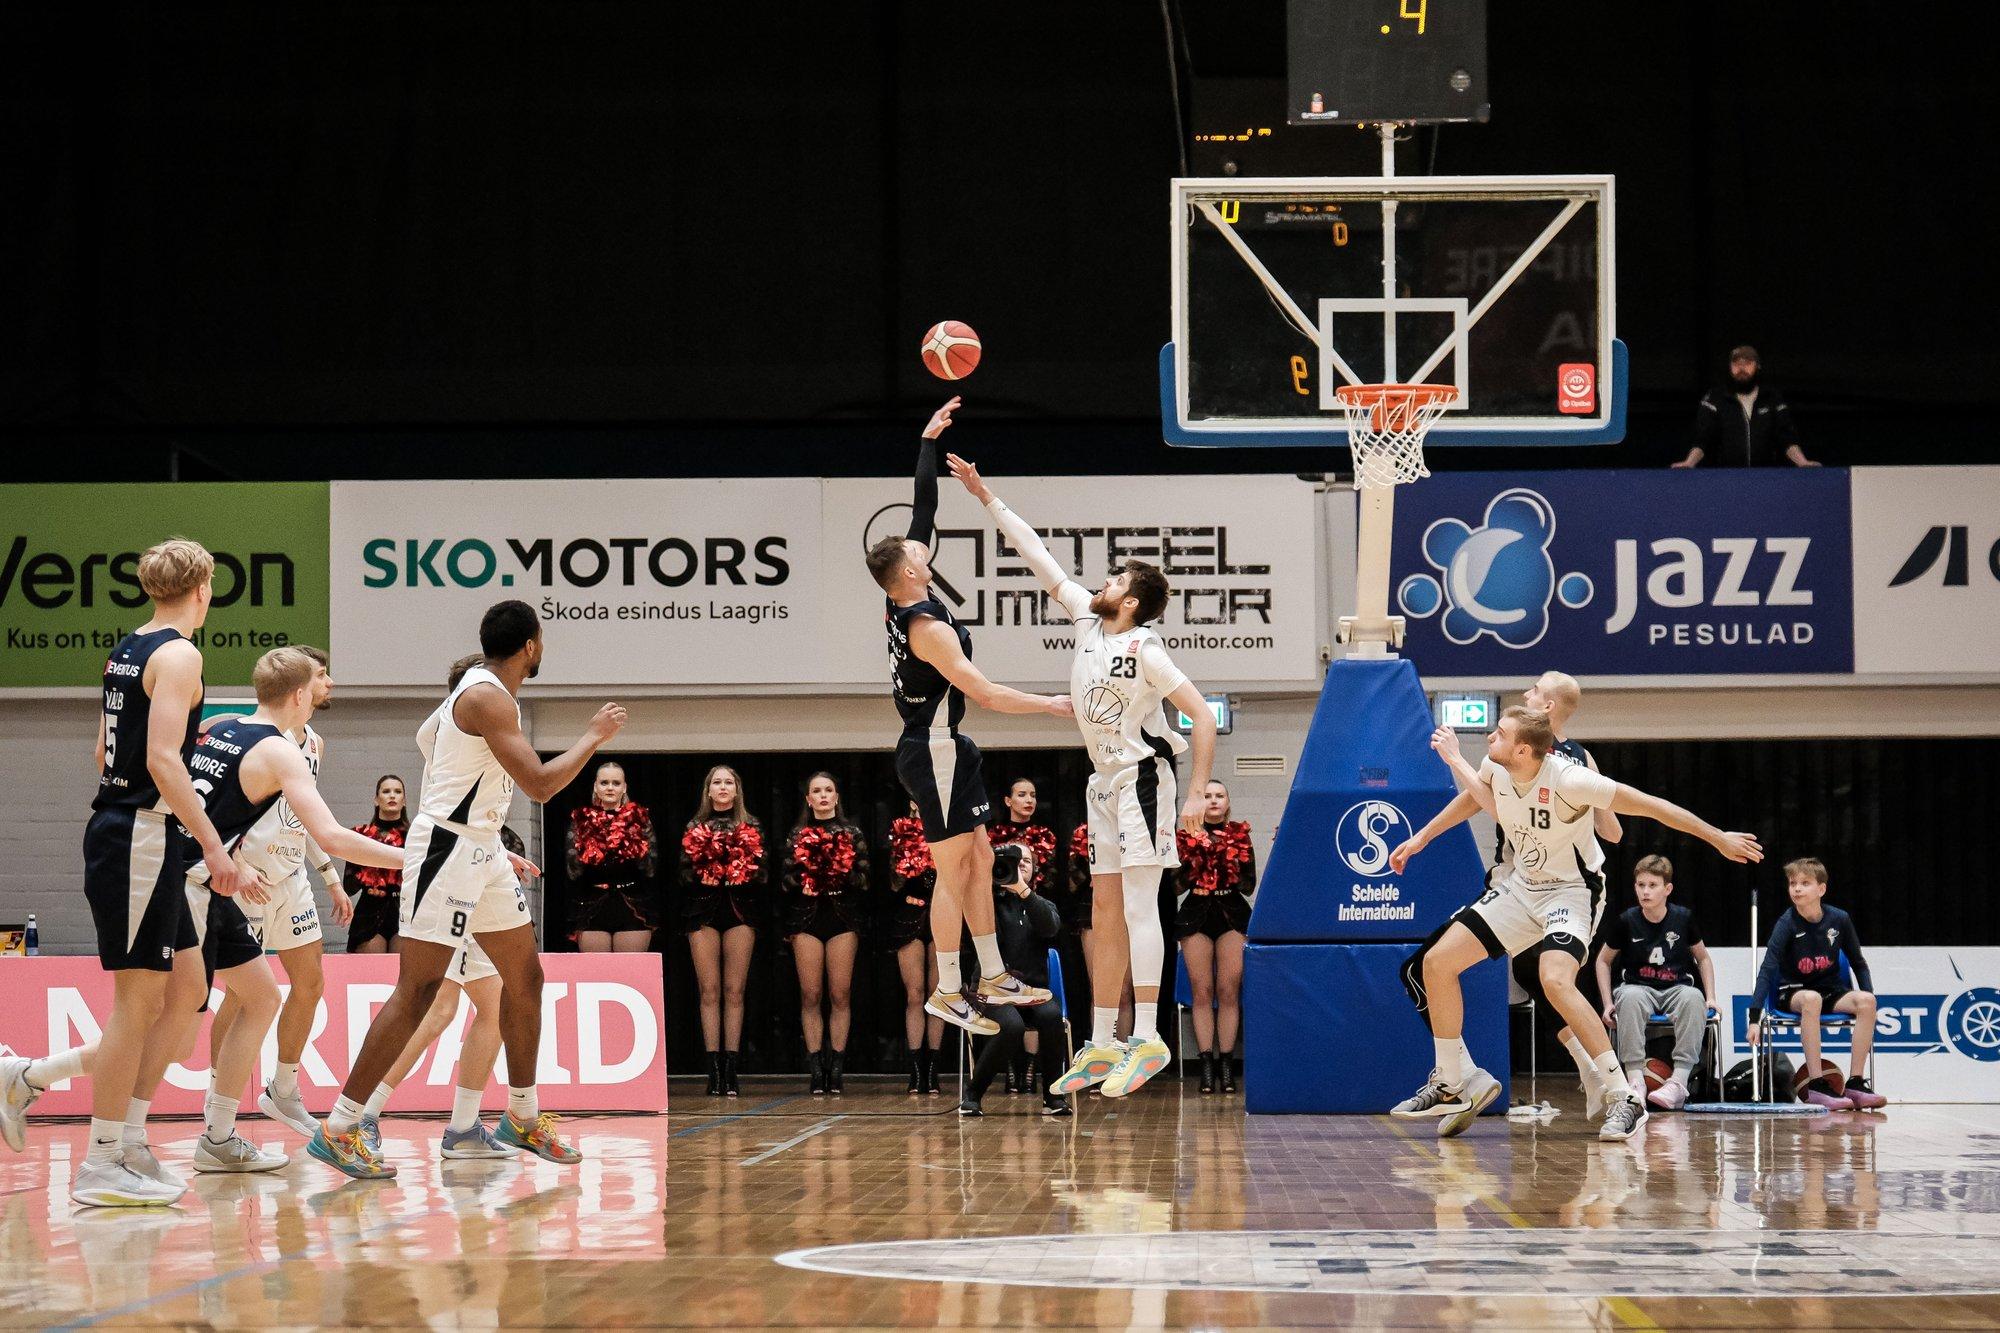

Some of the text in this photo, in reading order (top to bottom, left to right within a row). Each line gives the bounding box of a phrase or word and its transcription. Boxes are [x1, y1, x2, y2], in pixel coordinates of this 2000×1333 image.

[363, 536, 790, 588] SKO.MOTORS
[996, 526, 1271, 576] STEEL
[541, 596, 789, 624] Škoda esindus Laagris
[8, 628, 49, 648] Kus
[55, 632, 85, 648] on
[212, 632, 243, 648] on
[1649, 622, 1814, 645] PESULAD
[1109, 656, 1137, 679] 23
[104, 713, 118, 768] 5
[1529, 807, 1551, 829] 13
[1352, 883, 1400, 901] Schelde
[291, 909, 316, 925] Delfi
[1338, 902, 1415, 921] International
[450, 911, 467, 937] 9
[1649, 946, 1665, 965] 4
